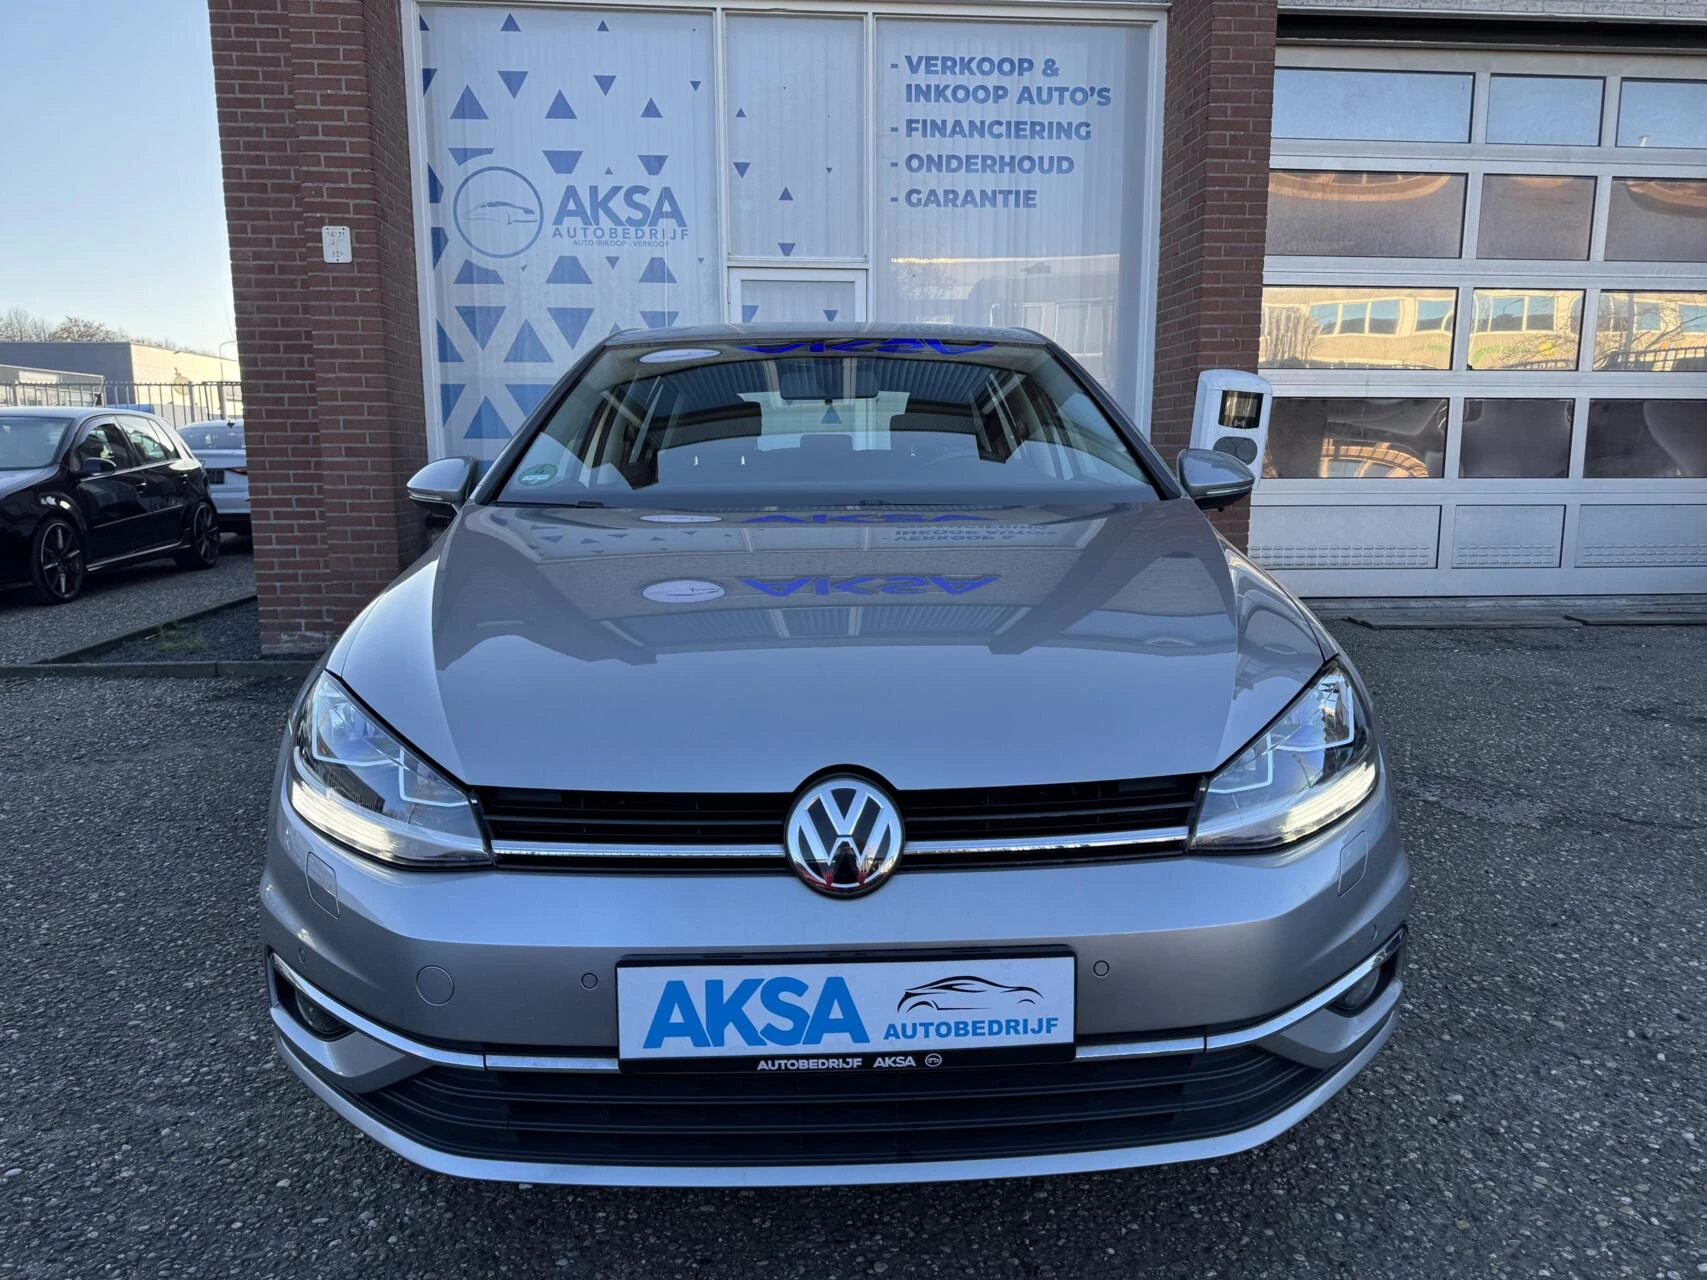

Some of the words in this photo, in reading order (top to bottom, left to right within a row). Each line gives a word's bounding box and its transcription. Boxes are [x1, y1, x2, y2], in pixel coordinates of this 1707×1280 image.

[904, 55, 1034, 76] VERKOOP
[1042, 58, 1060, 77] &
[905, 84, 1009, 104] INKOOP
[1016, 86, 1112, 106] AUTO'S
[905, 119, 1092, 140] FINANCIERING
[905, 154, 1074, 174] ONDERHOUD
[552, 185, 688, 228] AKSA
[905, 188, 1037, 208] GARANTIE
[552, 227, 689, 240] AUTOBEDRIJF
[793, 783, 896, 888] VW
[643, 976, 870, 1049] AKSA
[883, 1017, 1059, 1041] AUTOBEDRIJF
[757, 1058, 863, 1071] AUTOBEDRIJF
[873, 1056, 916, 1068] AKSA
